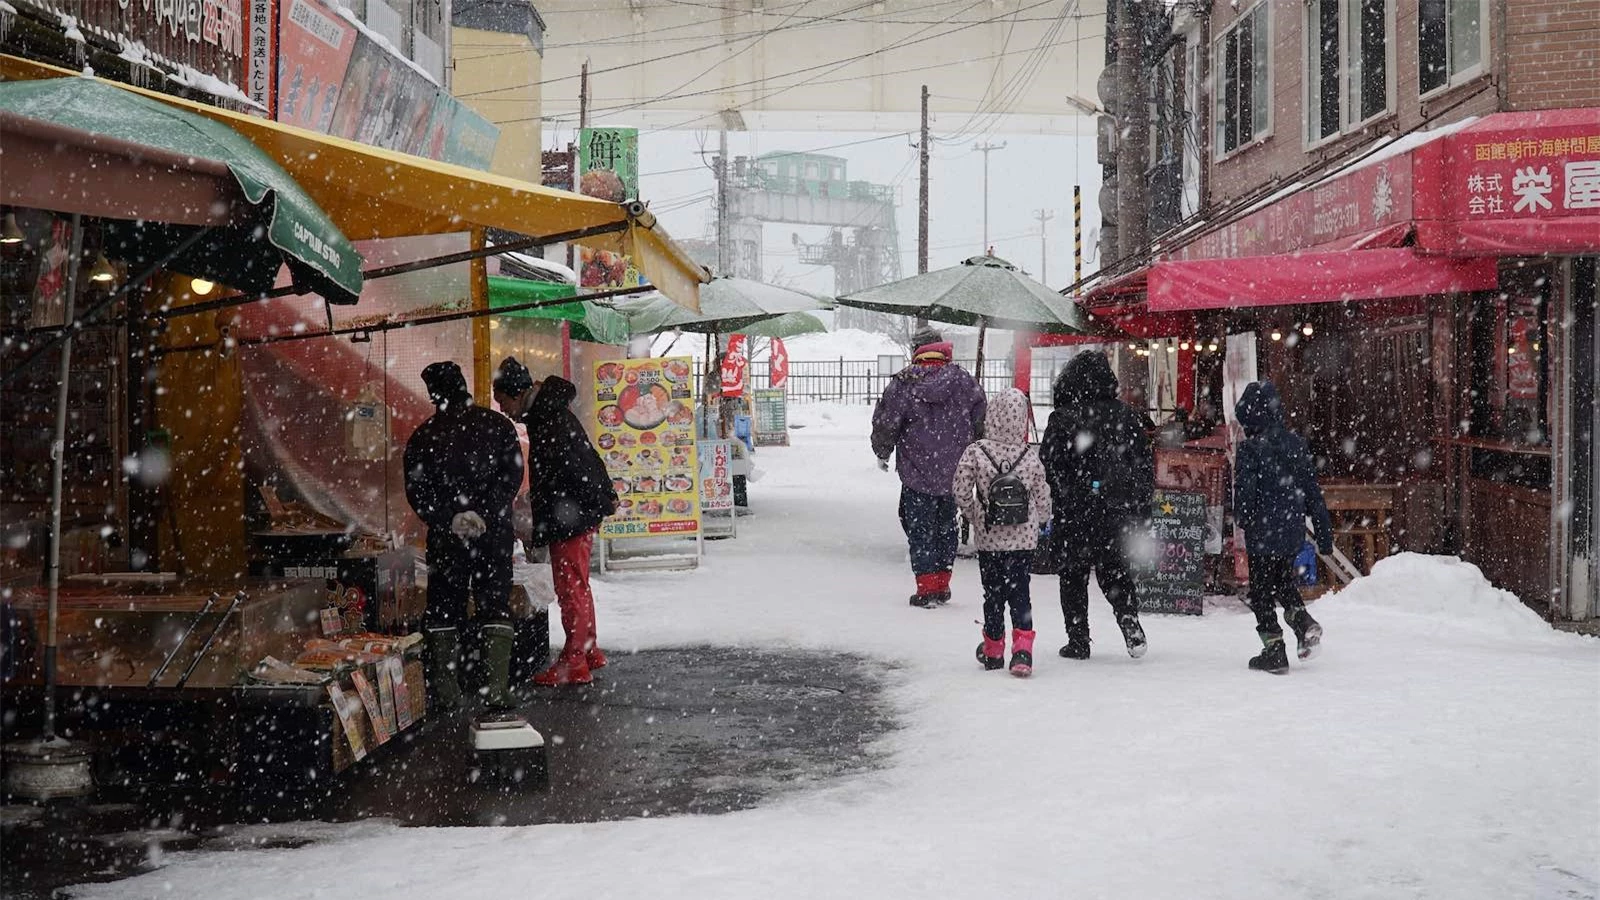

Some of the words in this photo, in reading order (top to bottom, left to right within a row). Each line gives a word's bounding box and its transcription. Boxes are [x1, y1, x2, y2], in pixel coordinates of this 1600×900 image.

[588, 131, 622, 170] 鮮
[1475, 136, 1600, 160] 函館朝市海鮮問屋
[1467, 173, 1504, 193] 株式
[1511, 161, 1600, 214] 栄屋
[1469, 195, 1504, 214] 会社
[714, 444, 727, 487] いか釣り
